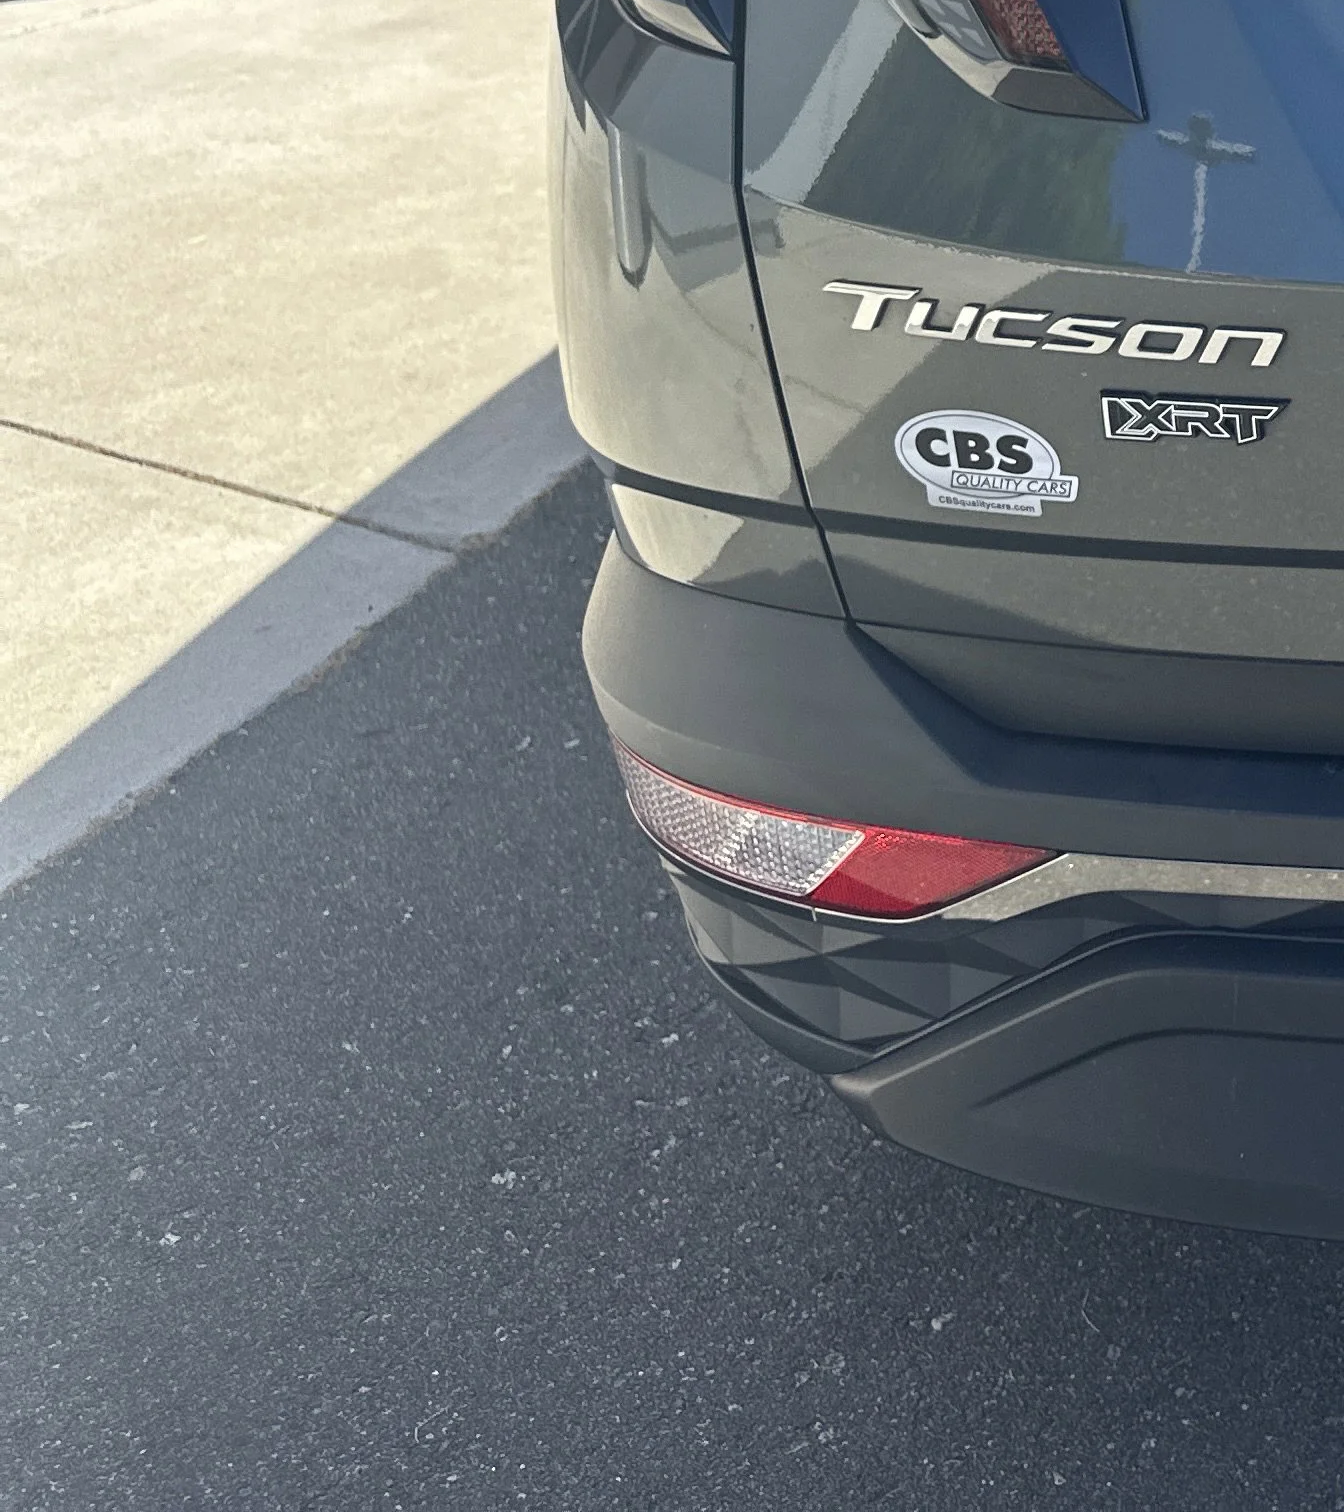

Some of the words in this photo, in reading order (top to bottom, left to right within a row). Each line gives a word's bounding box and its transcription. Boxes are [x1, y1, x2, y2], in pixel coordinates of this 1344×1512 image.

[915, 426, 1034, 475] CBS
[955, 473, 1022, 492] QUALITY
[1027, 480, 1068, 496] CARS
